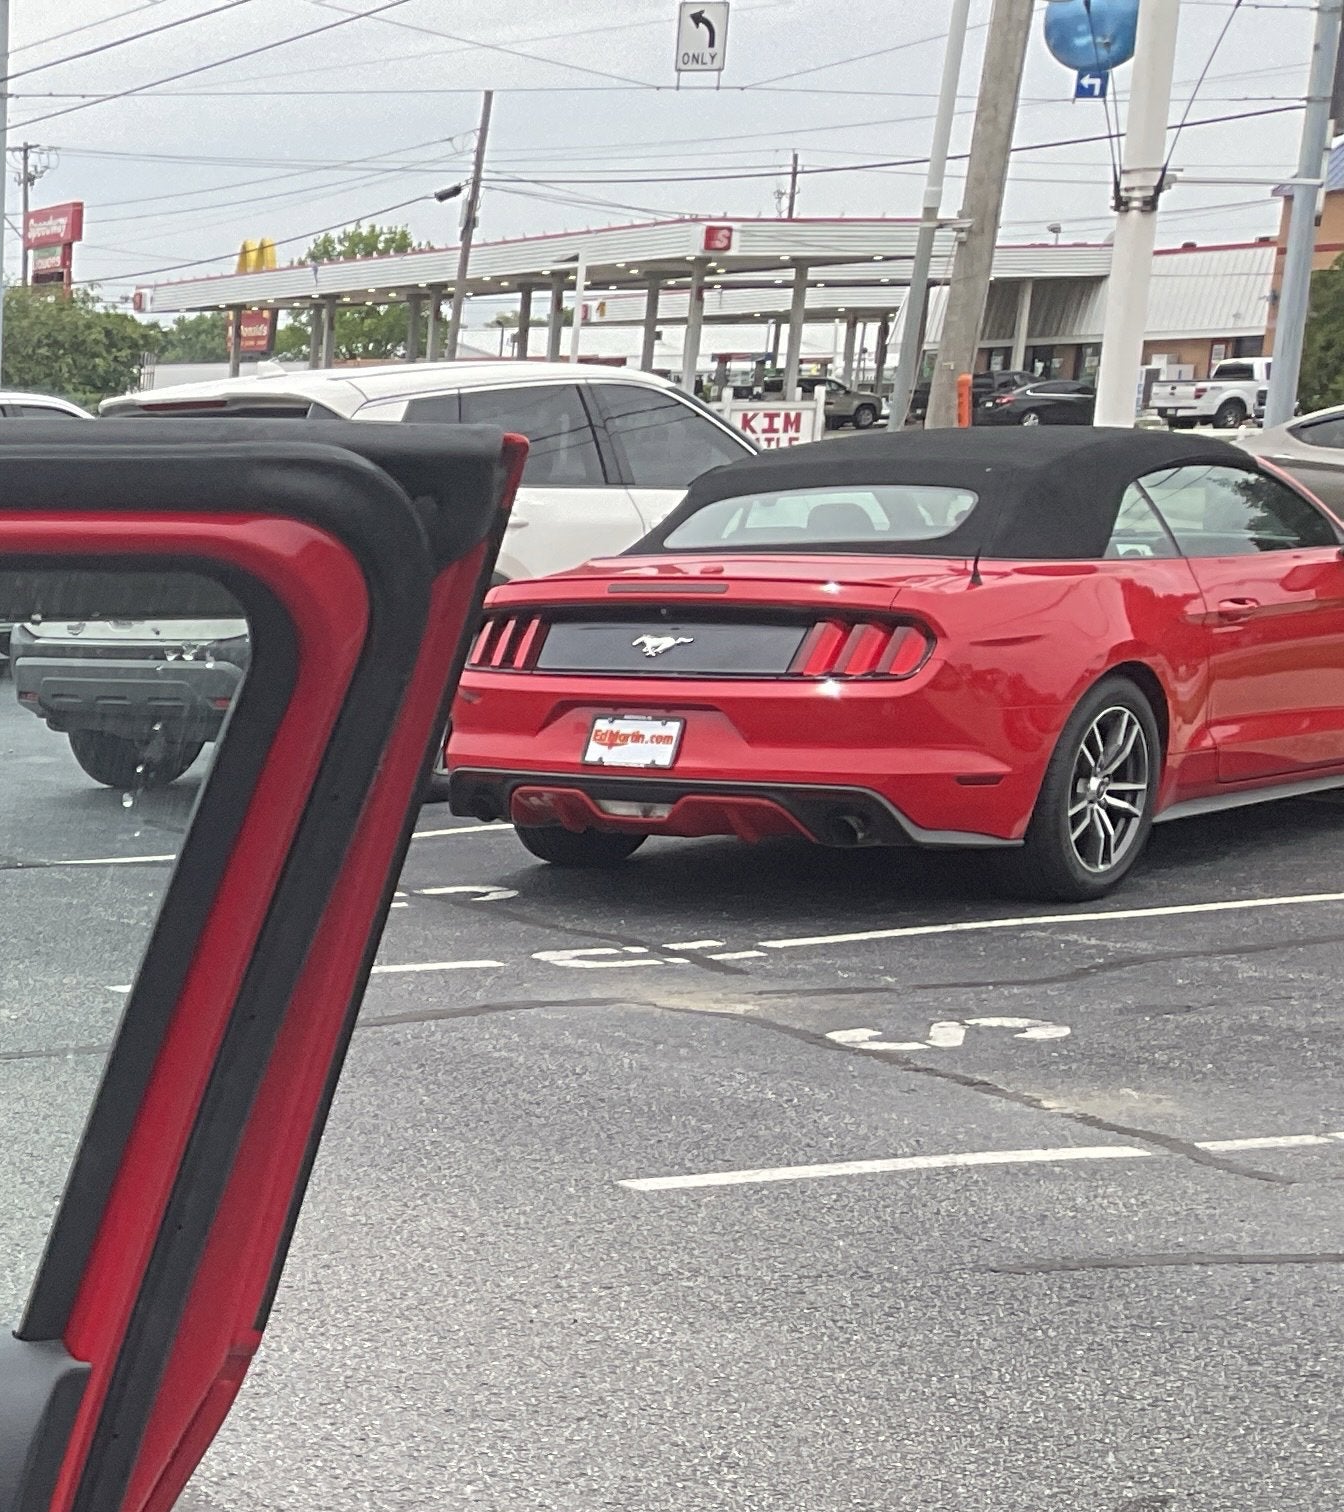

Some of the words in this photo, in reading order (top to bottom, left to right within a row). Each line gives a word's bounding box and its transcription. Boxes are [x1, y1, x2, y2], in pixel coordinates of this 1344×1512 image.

[682, 52, 717, 66] ONLY
[28, 215, 68, 241] Speedway
[741, 412, 802, 434] KIM
